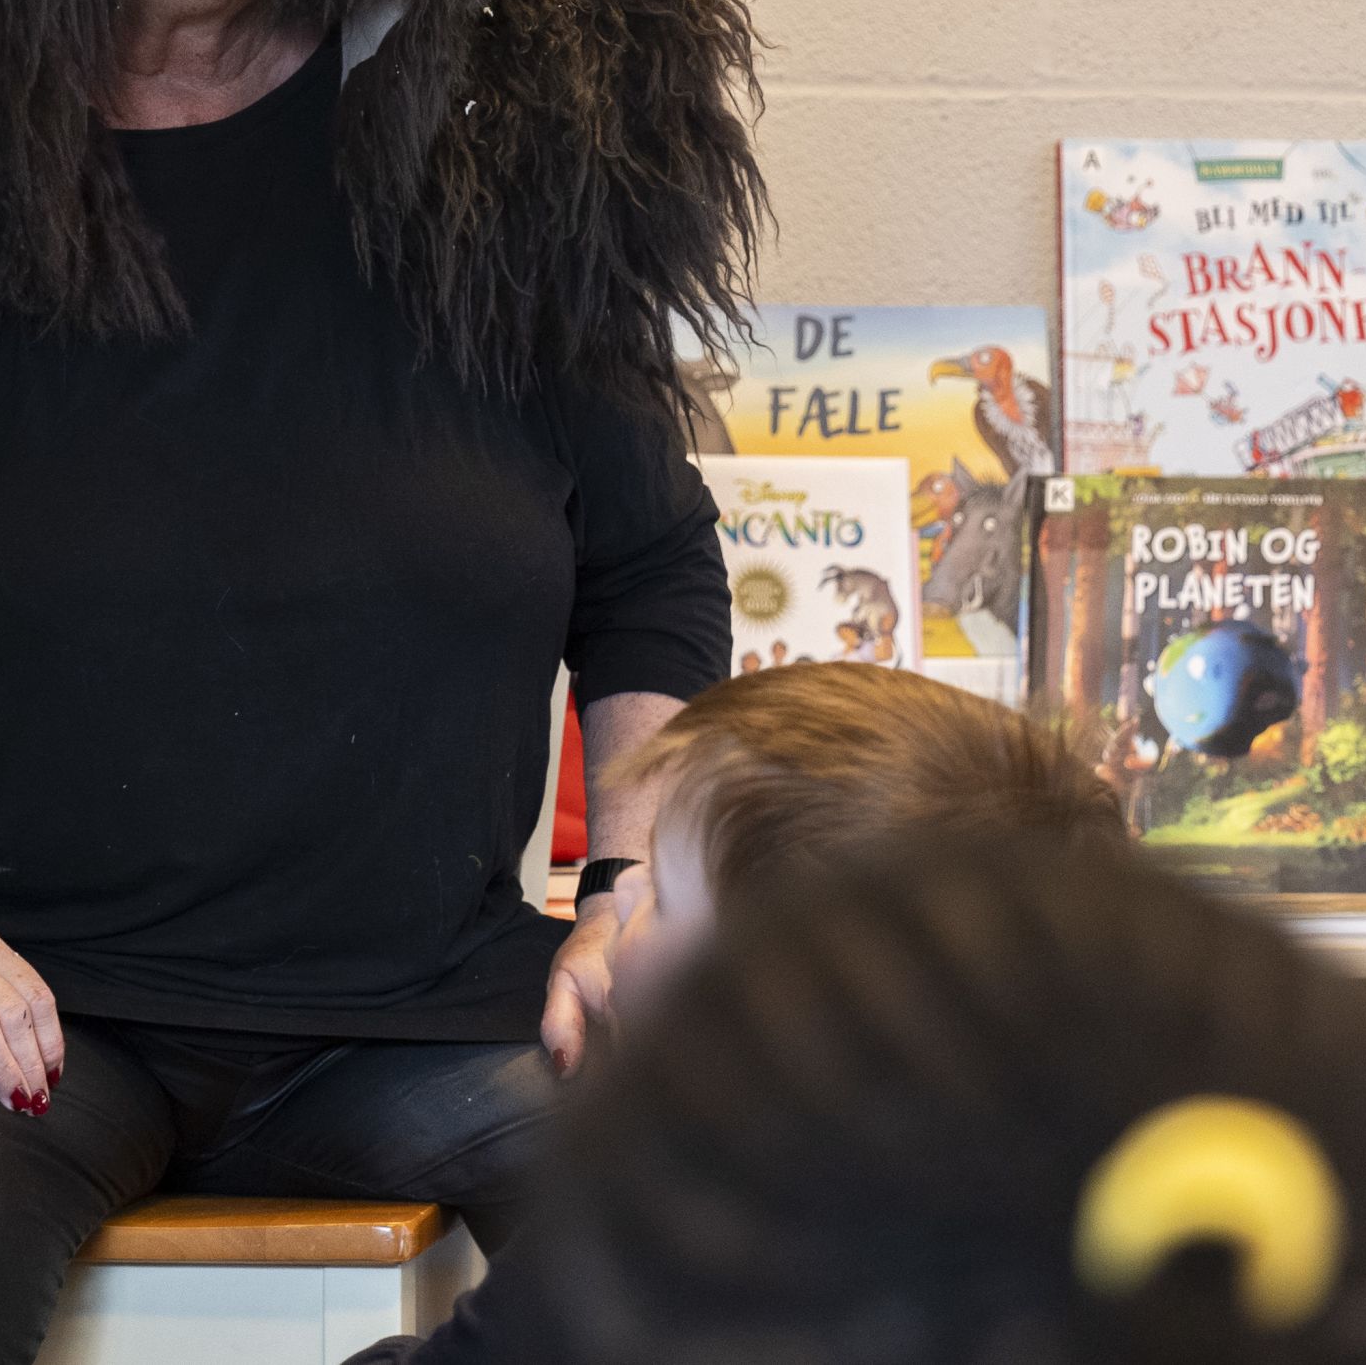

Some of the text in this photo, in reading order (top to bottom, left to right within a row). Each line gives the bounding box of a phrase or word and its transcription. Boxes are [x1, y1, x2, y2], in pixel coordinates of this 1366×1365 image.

[1083, 150, 1101, 170] A
[1195, 195, 1358, 234] BLI MED TIL
[795, 313, 856, 362] DE
[768, 386, 903, 439] FÆLE
[715, 509, 865, 549] NCANTO
[1132, 522, 1321, 564] ROBIN OG
[1133, 571, 1316, 614] PLANETEN
